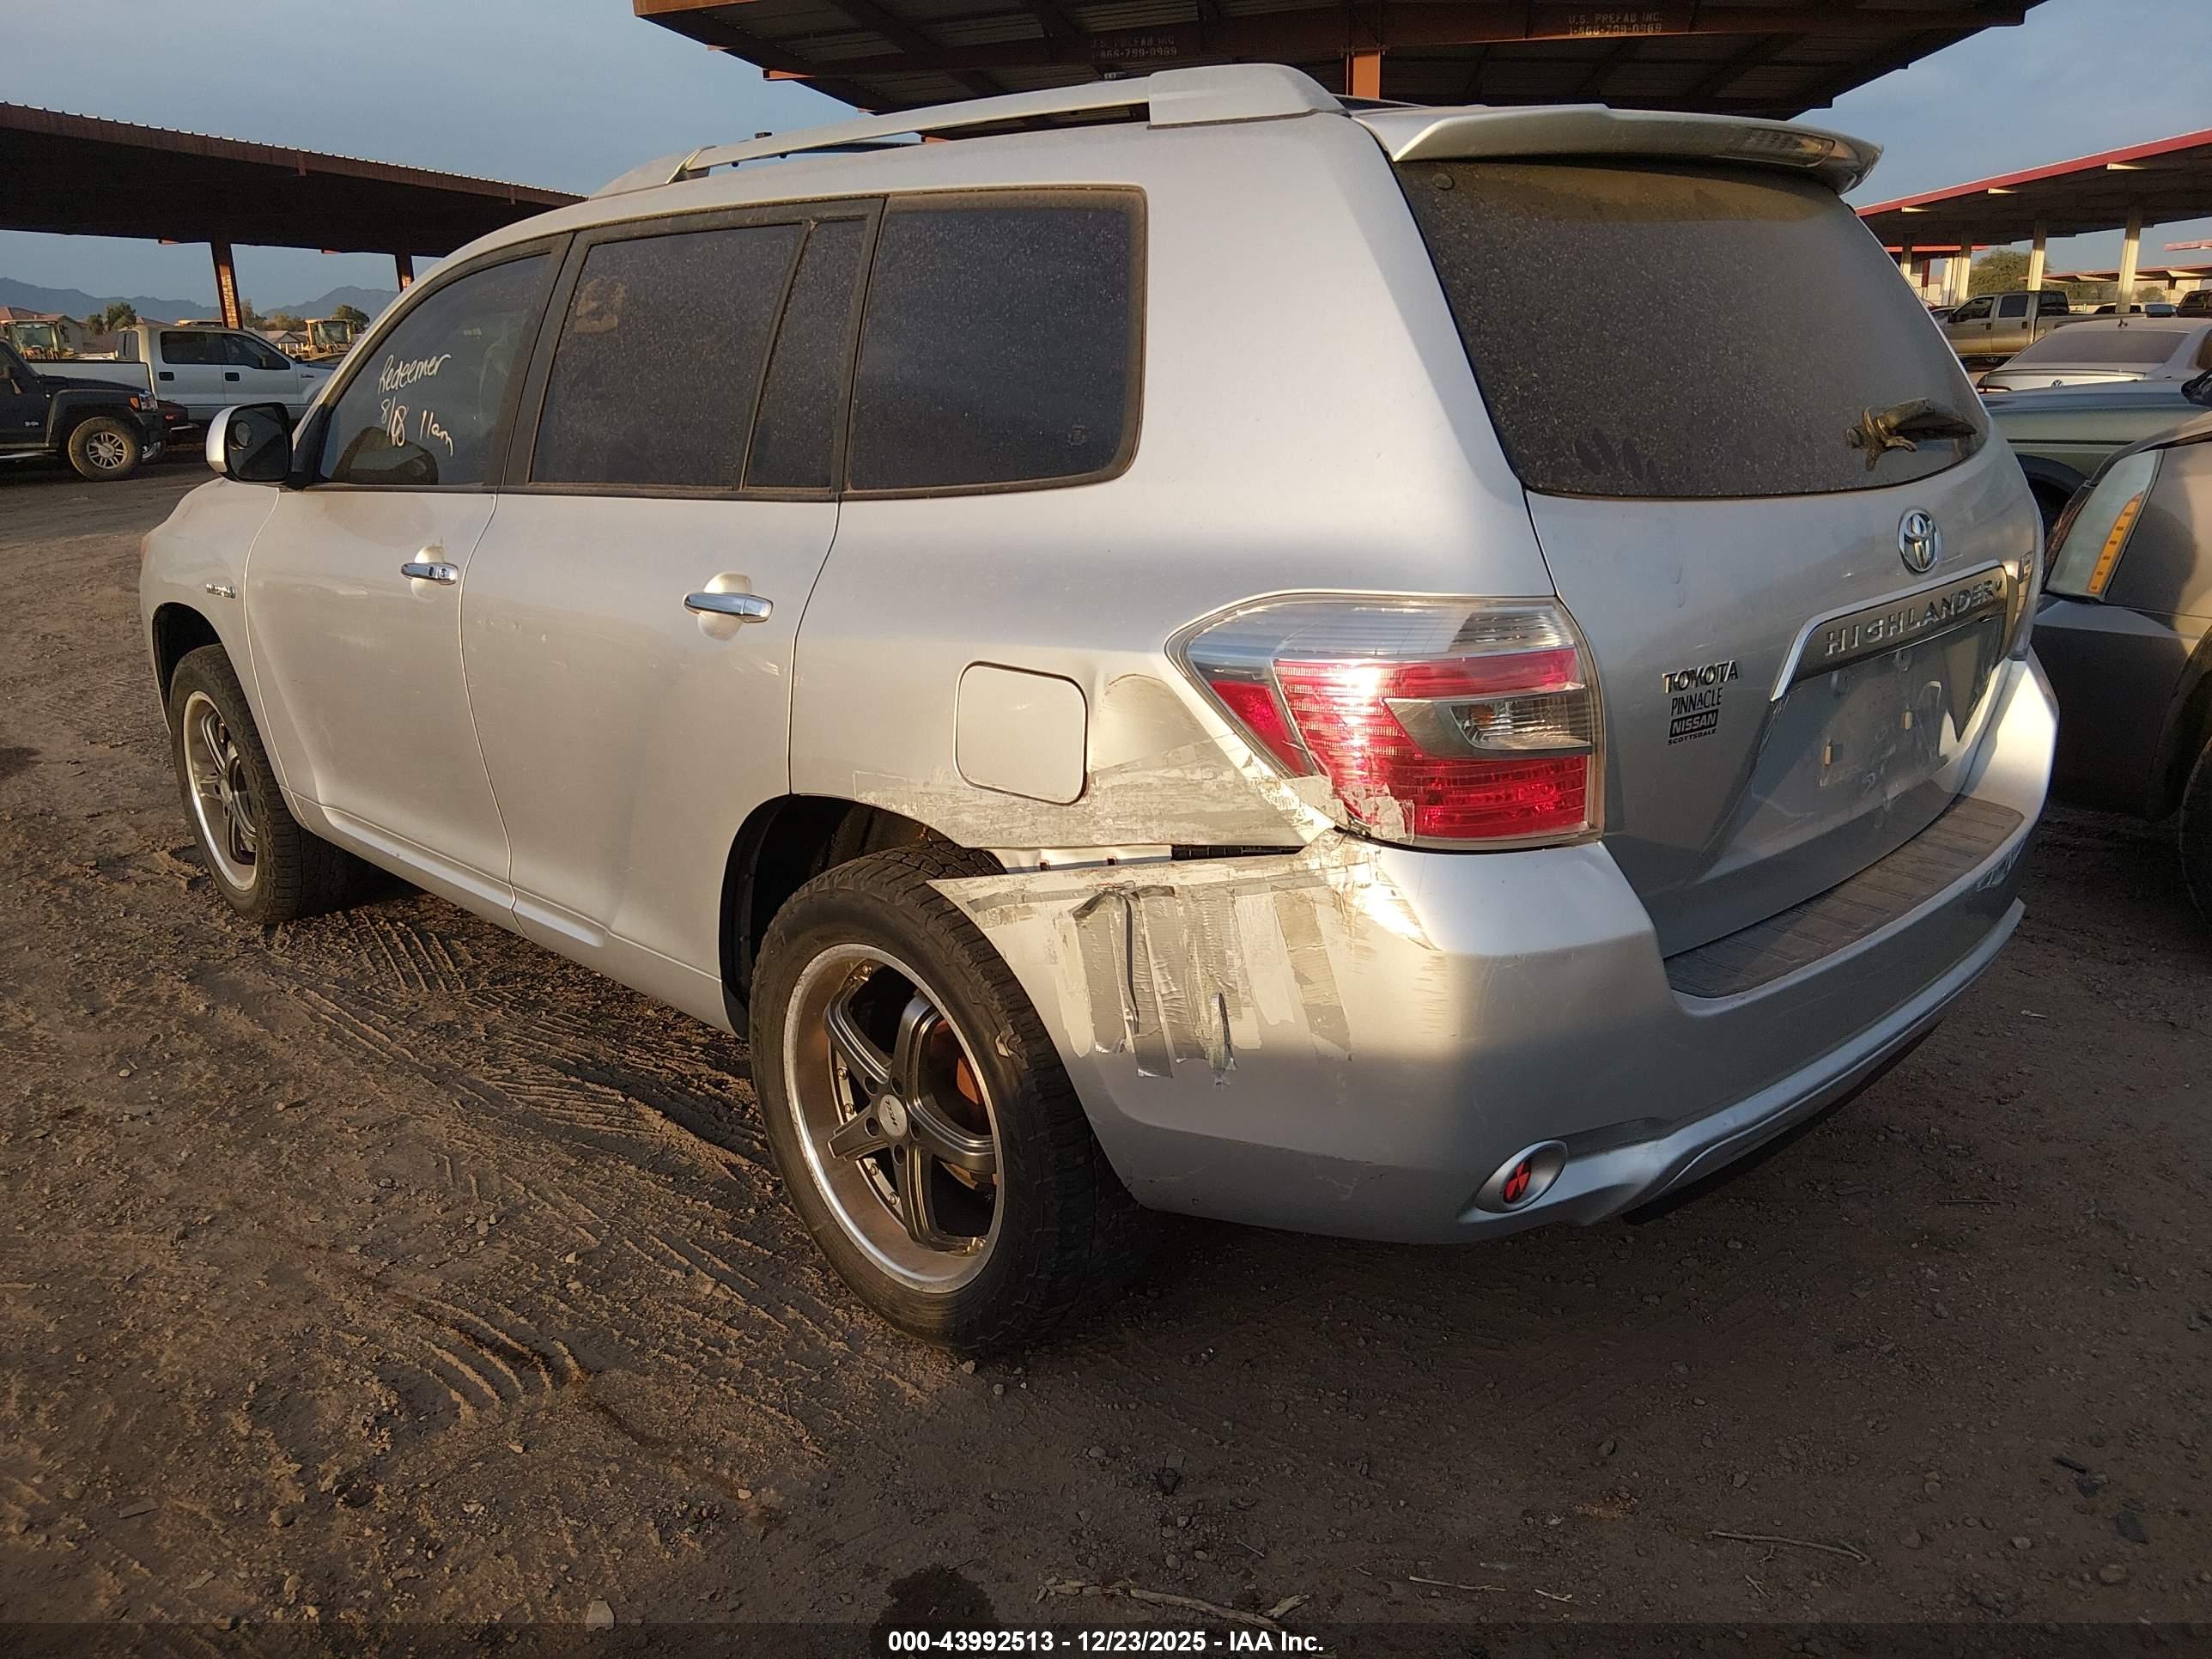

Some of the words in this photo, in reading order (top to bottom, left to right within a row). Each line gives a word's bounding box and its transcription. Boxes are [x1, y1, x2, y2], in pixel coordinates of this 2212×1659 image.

[1825, 579, 1995, 656] HIGHLANDER
[1662, 660, 1738, 694] TOYOTA
[1671, 687, 1723, 716] PINNACLE
[1668, 728, 1717, 745] SCOTTSDALE
[1671, 712, 1717, 735] NISSAN
